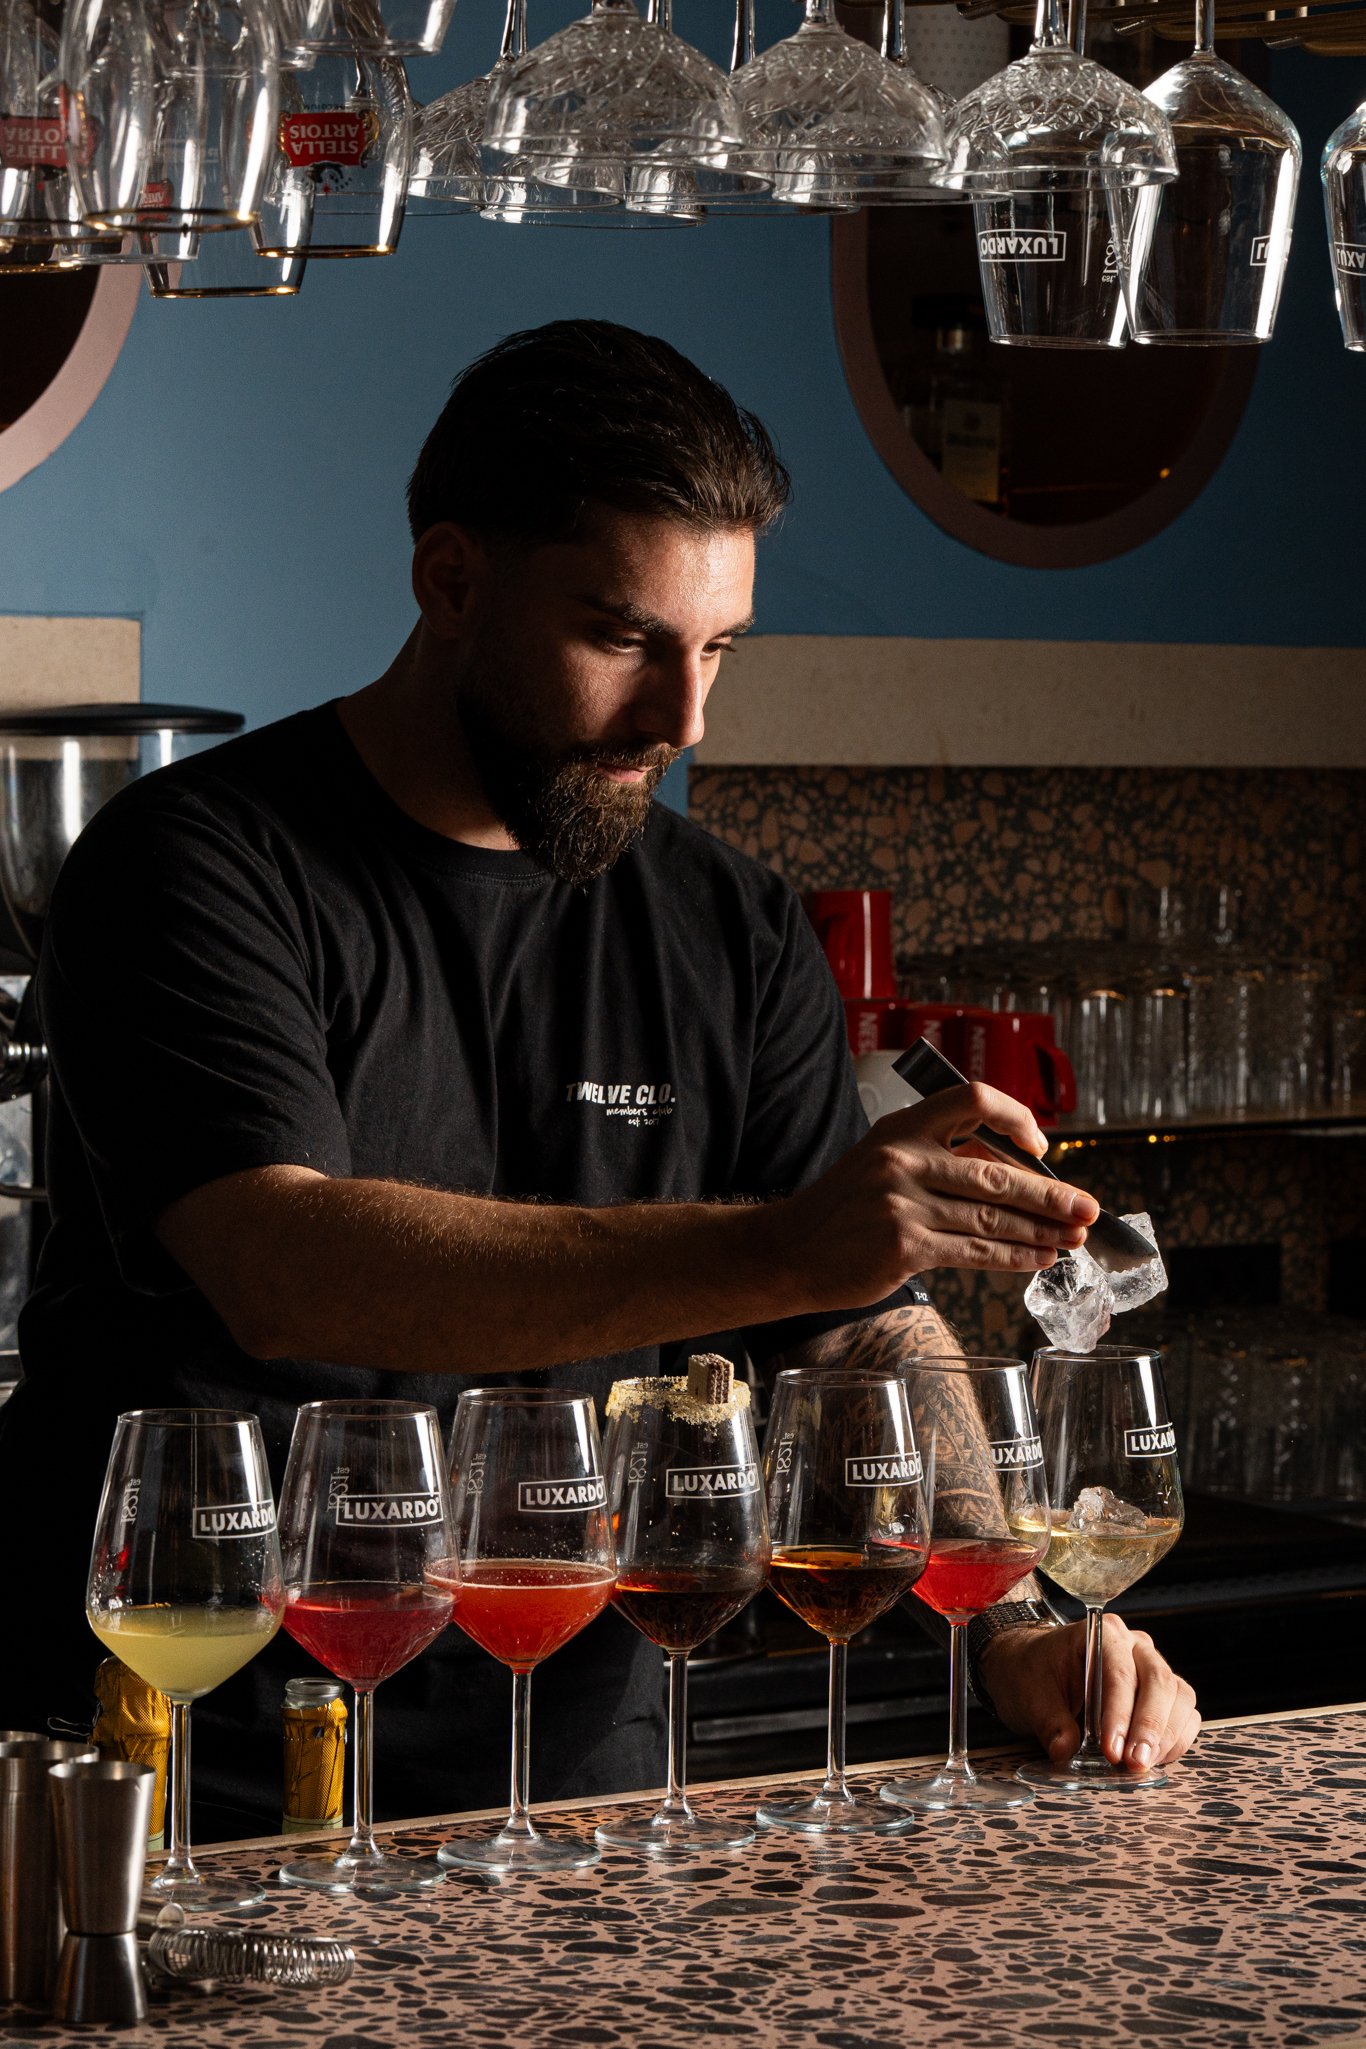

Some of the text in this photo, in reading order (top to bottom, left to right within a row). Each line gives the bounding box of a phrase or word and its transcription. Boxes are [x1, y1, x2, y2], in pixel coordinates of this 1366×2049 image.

[289, 124, 360, 139] ARTOIS
[290, 141, 359, 155] STELLA
[980, 236, 1059, 256] LUXARDO
[566, 1081, 676, 1105] TWELVE CLO.
[606, 1105, 648, 1116] members
[991, 1441, 1042, 1465] UXARDO
[852, 1456, 921, 1481] LUXARDO
[673, 1469, 757, 1493] LUXARDO
[525, 1481, 604, 1506] LUXARDO
[200, 1504, 274, 1532] LUXARDO
[343, 1497, 439, 1520] LUXARDO
